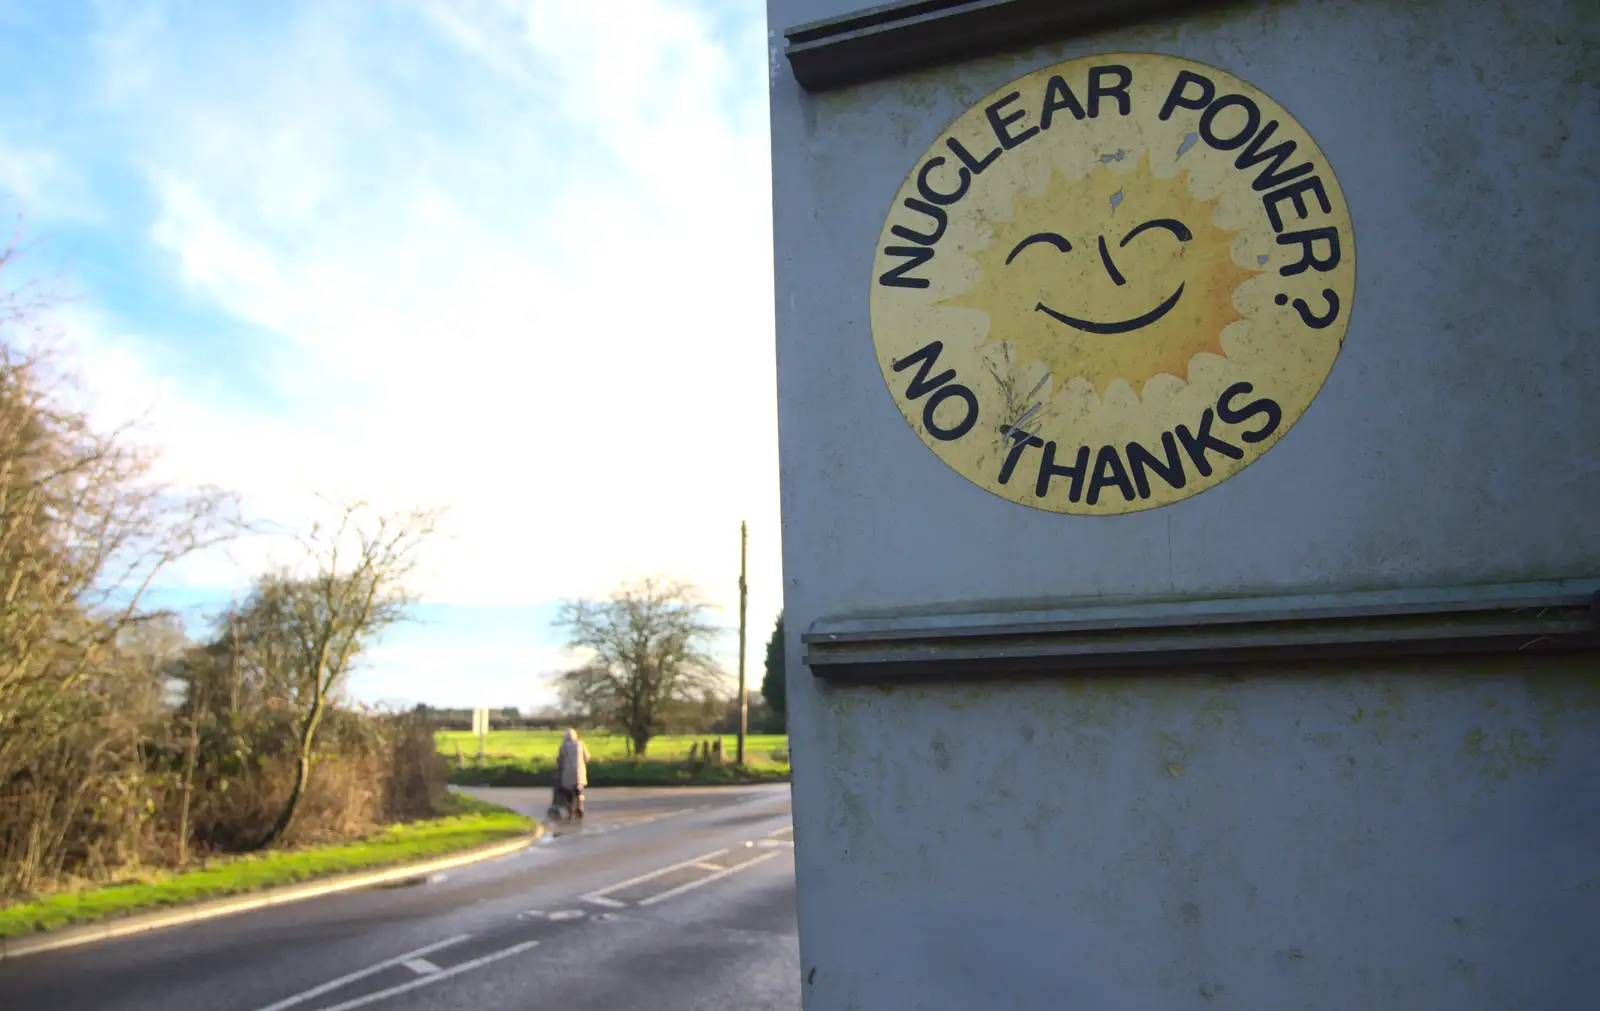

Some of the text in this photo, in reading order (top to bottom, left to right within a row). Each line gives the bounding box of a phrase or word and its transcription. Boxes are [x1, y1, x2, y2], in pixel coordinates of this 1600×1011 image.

[879, 65, 1341, 329] NUCLEAR POWER?
[893, 341, 1282, 505] NO THANKS
